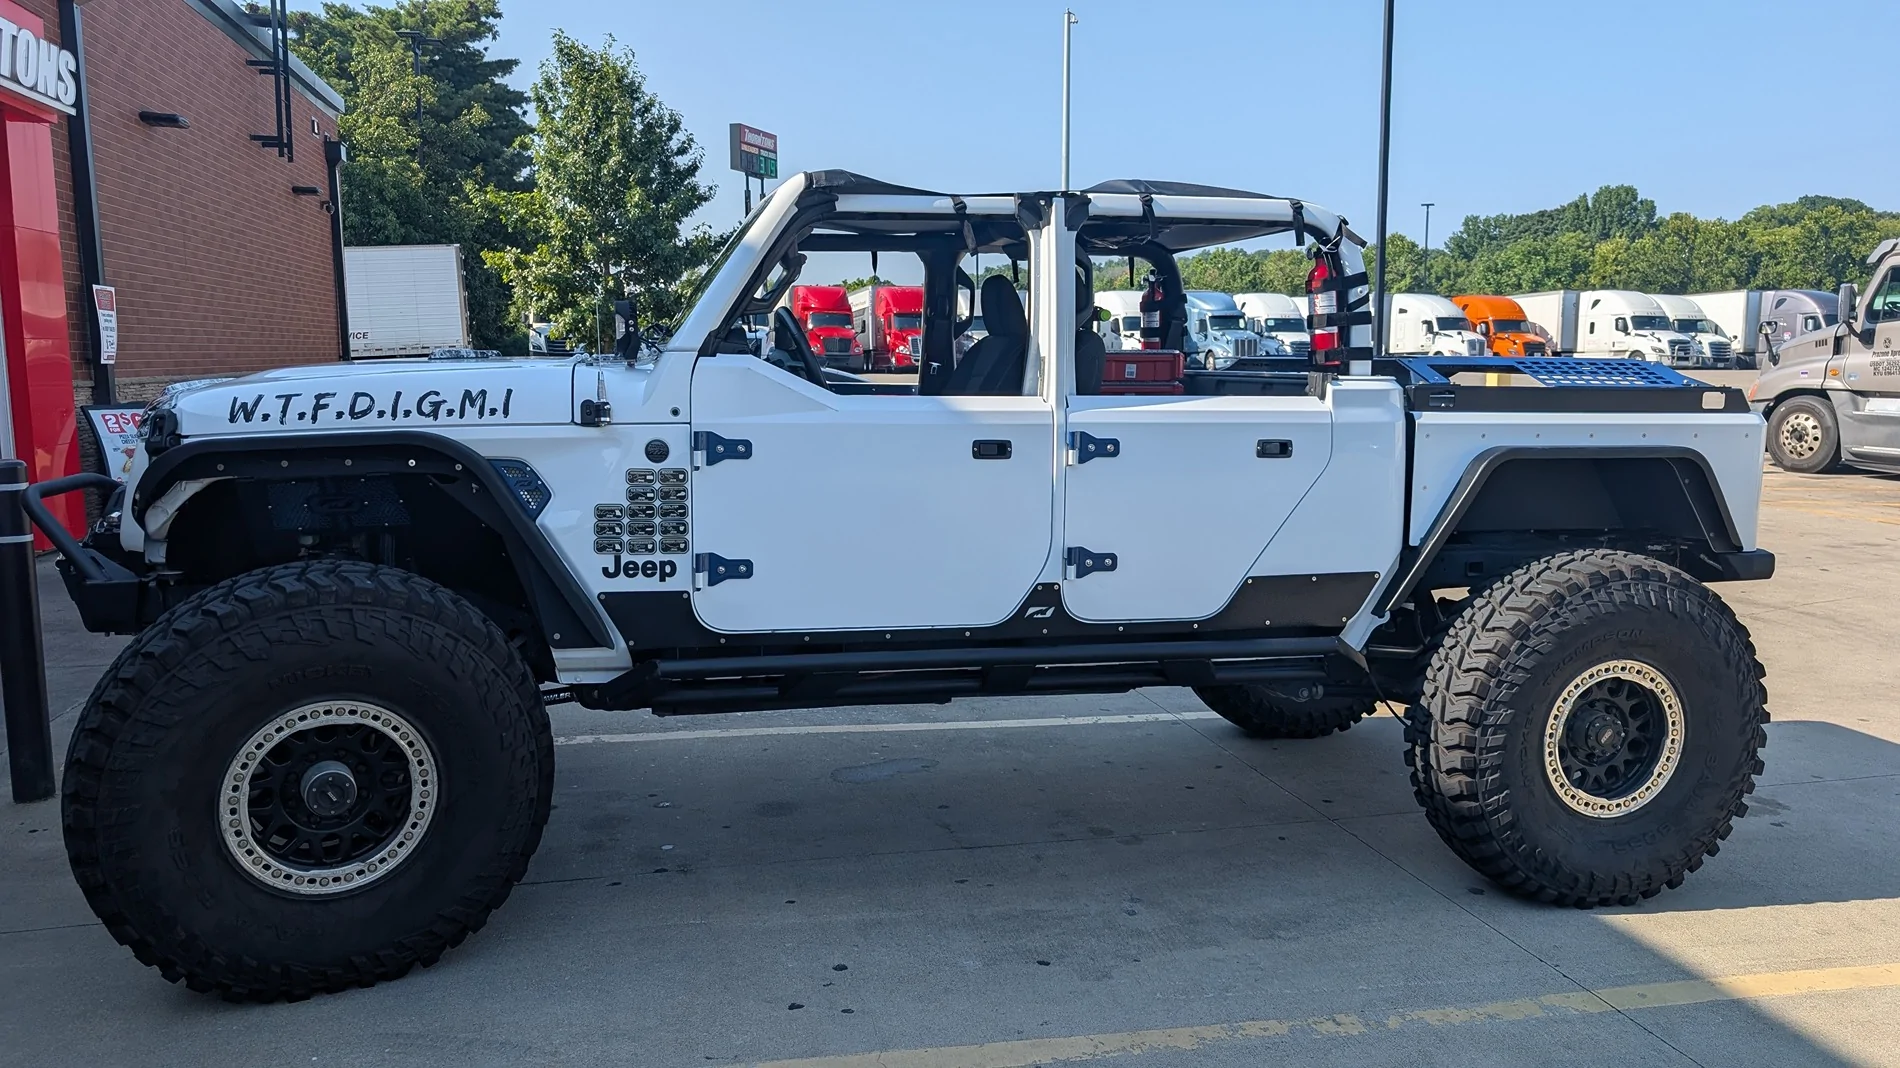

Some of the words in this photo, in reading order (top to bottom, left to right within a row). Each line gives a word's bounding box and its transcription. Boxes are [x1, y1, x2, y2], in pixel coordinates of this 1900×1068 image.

[0, 16, 77, 106] TONS
[104, 414, 119, 428] 2
[228, 388, 514, 426] W.T.F.D.I.G.M.I
[601, 554, 677, 583] Jeep
